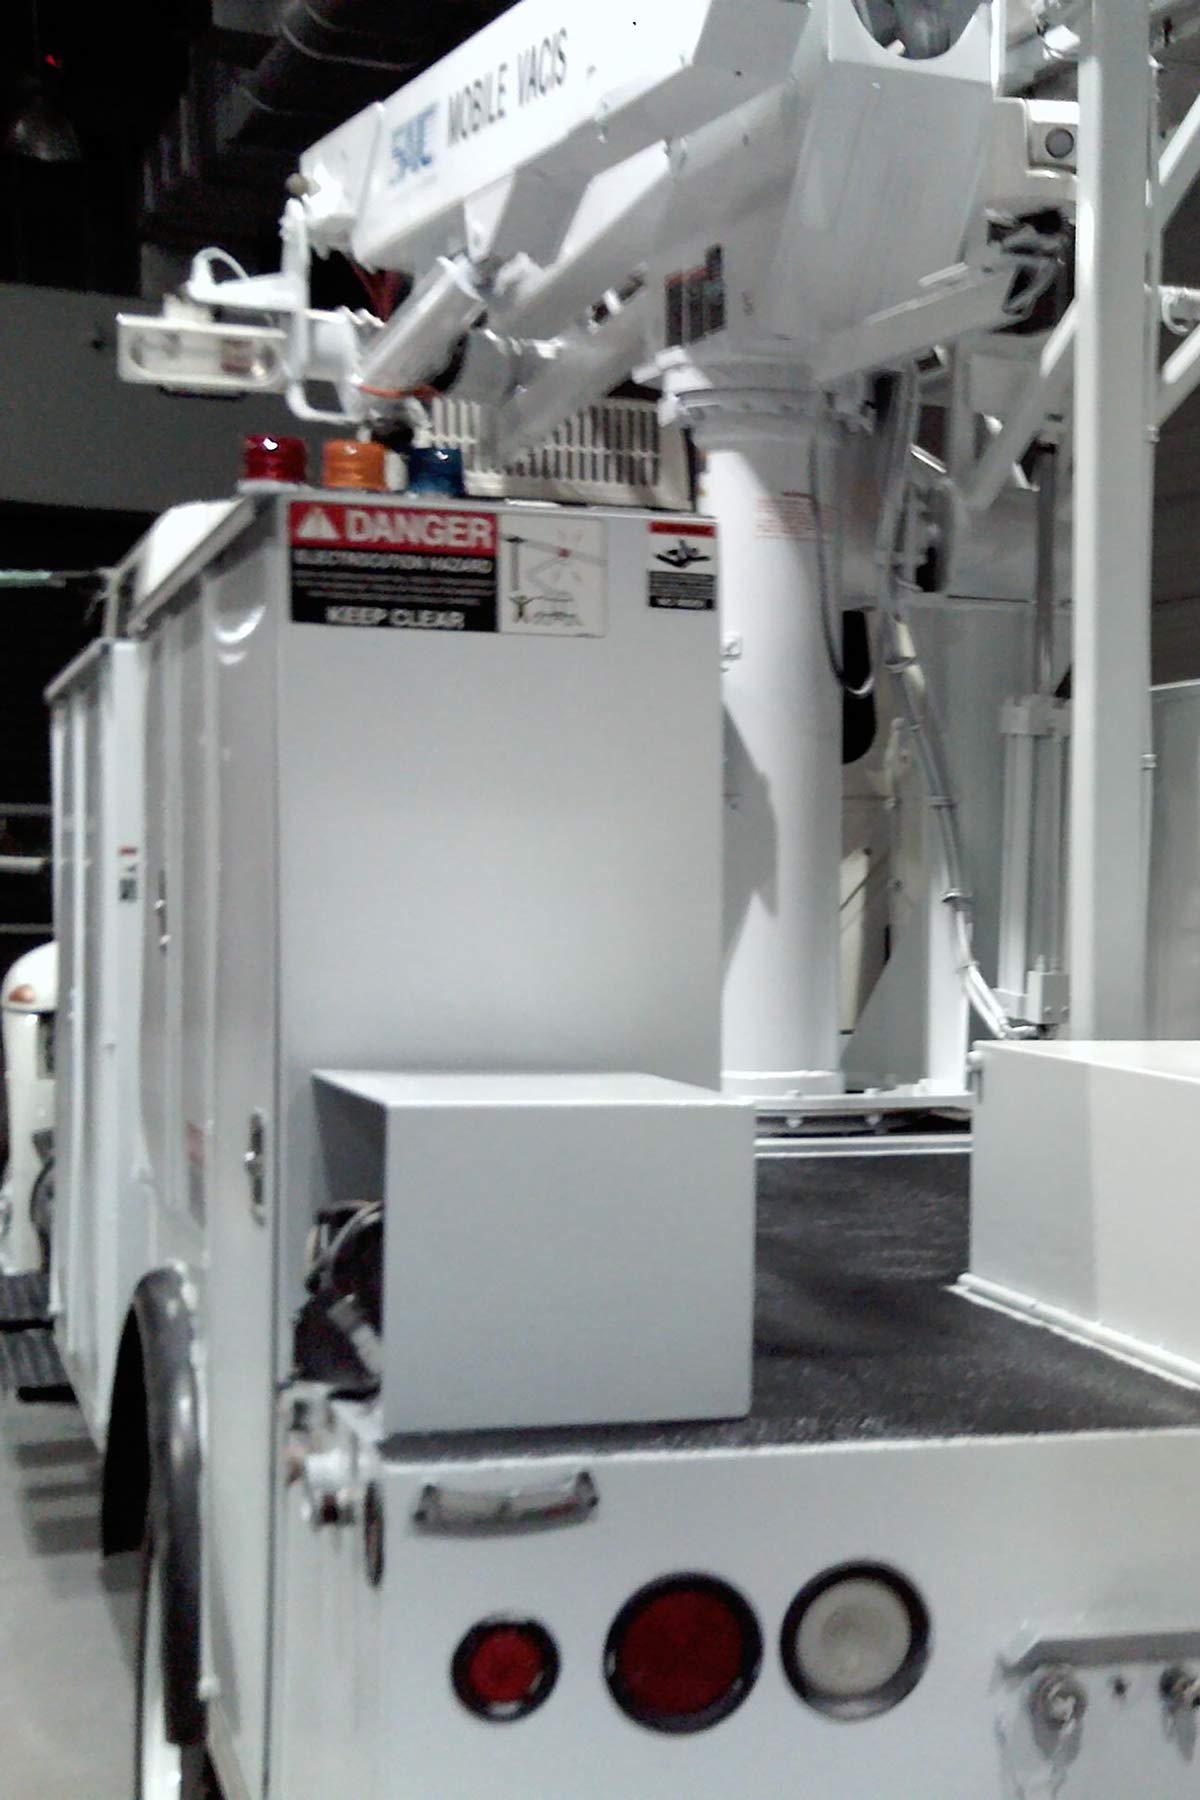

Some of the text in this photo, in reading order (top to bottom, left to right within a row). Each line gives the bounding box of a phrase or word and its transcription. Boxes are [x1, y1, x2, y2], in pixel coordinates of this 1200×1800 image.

[344, 508, 494, 549] DANGER
[325, 605, 466, 630] KEEP CLEAR
